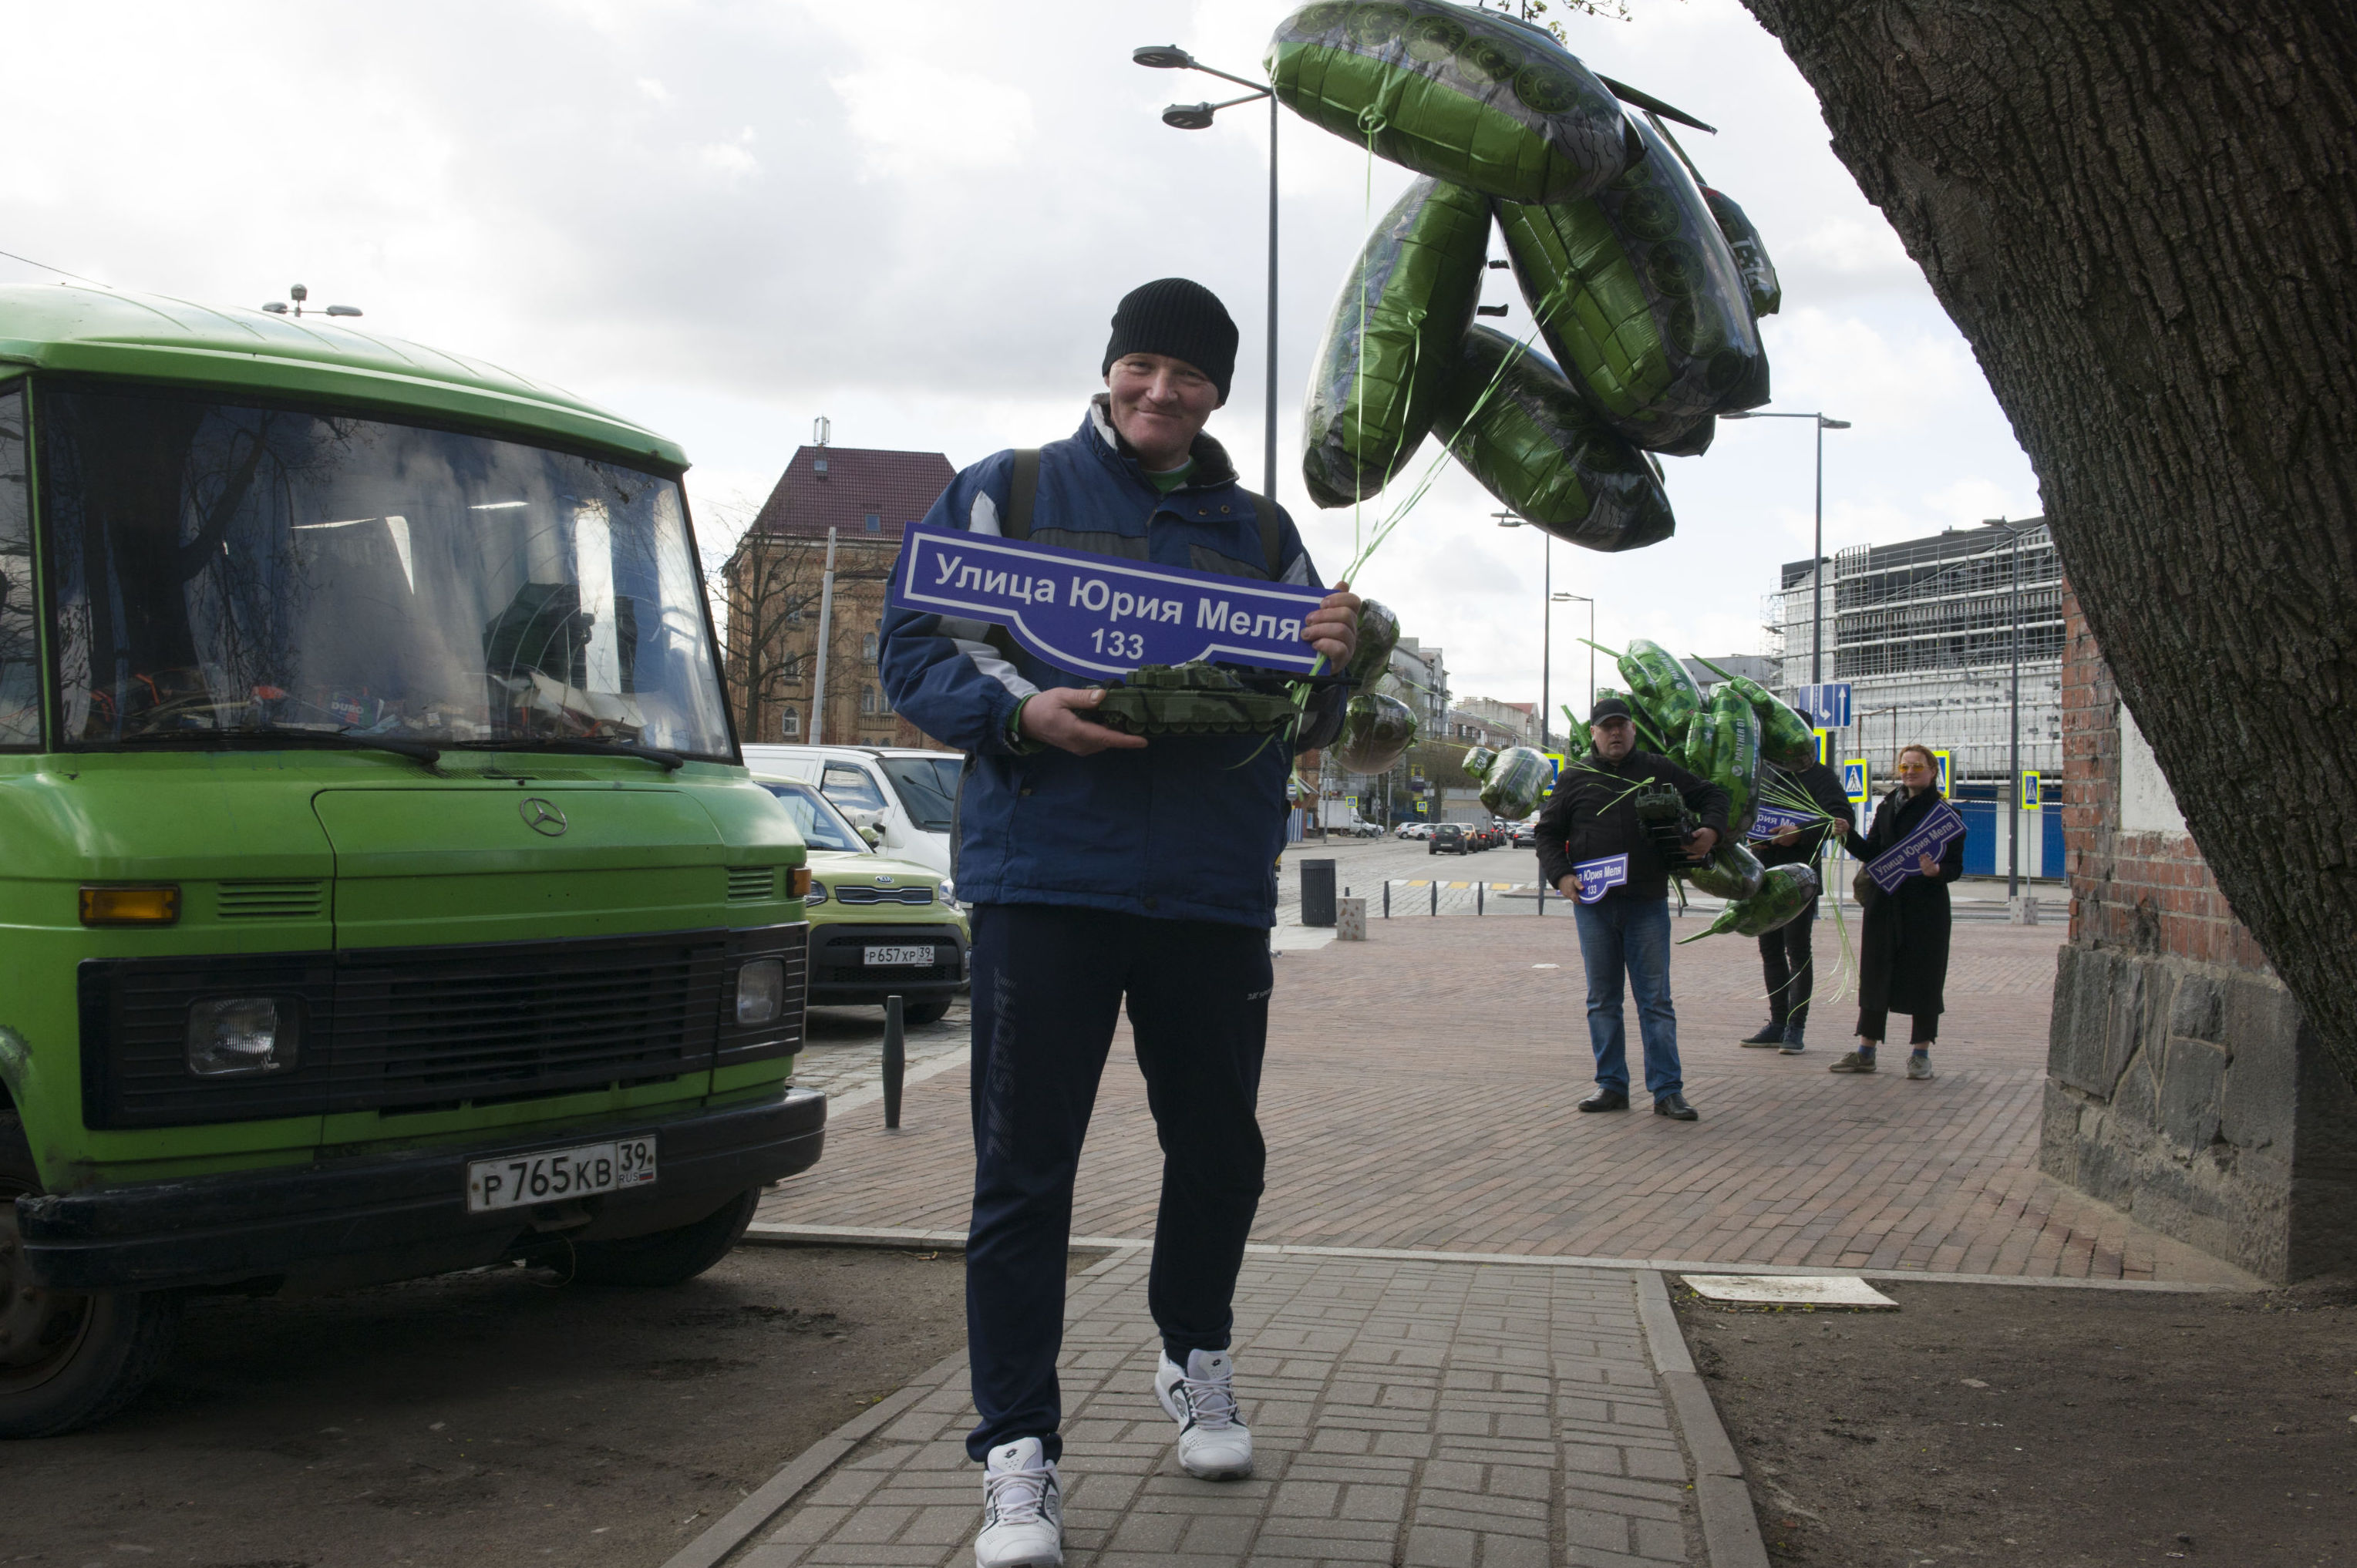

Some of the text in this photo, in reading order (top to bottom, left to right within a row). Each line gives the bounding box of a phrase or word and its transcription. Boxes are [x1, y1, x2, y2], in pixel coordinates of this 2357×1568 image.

[935, 553, 1301, 643] Улица Юрия Меля
[1091, 629, 1144, 660] 133
[1735, 718, 1745, 762] PANTHER 01
[1757, 814, 1777, 824] рия
[1875, 854, 1905, 876] Улица
[1902, 837, 1931, 858] Юрия
[1928, 821, 1955, 841] Меля
[1584, 870, 1603, 883] Юрия
[1604, 866, 1621, 877] Меля
[1588, 884, 1597, 894] 133
[919, 947, 931, 957] 39
[484, 1142, 647, 1205] Р765КВ 39
[618, 1172, 638, 1184] RUS
